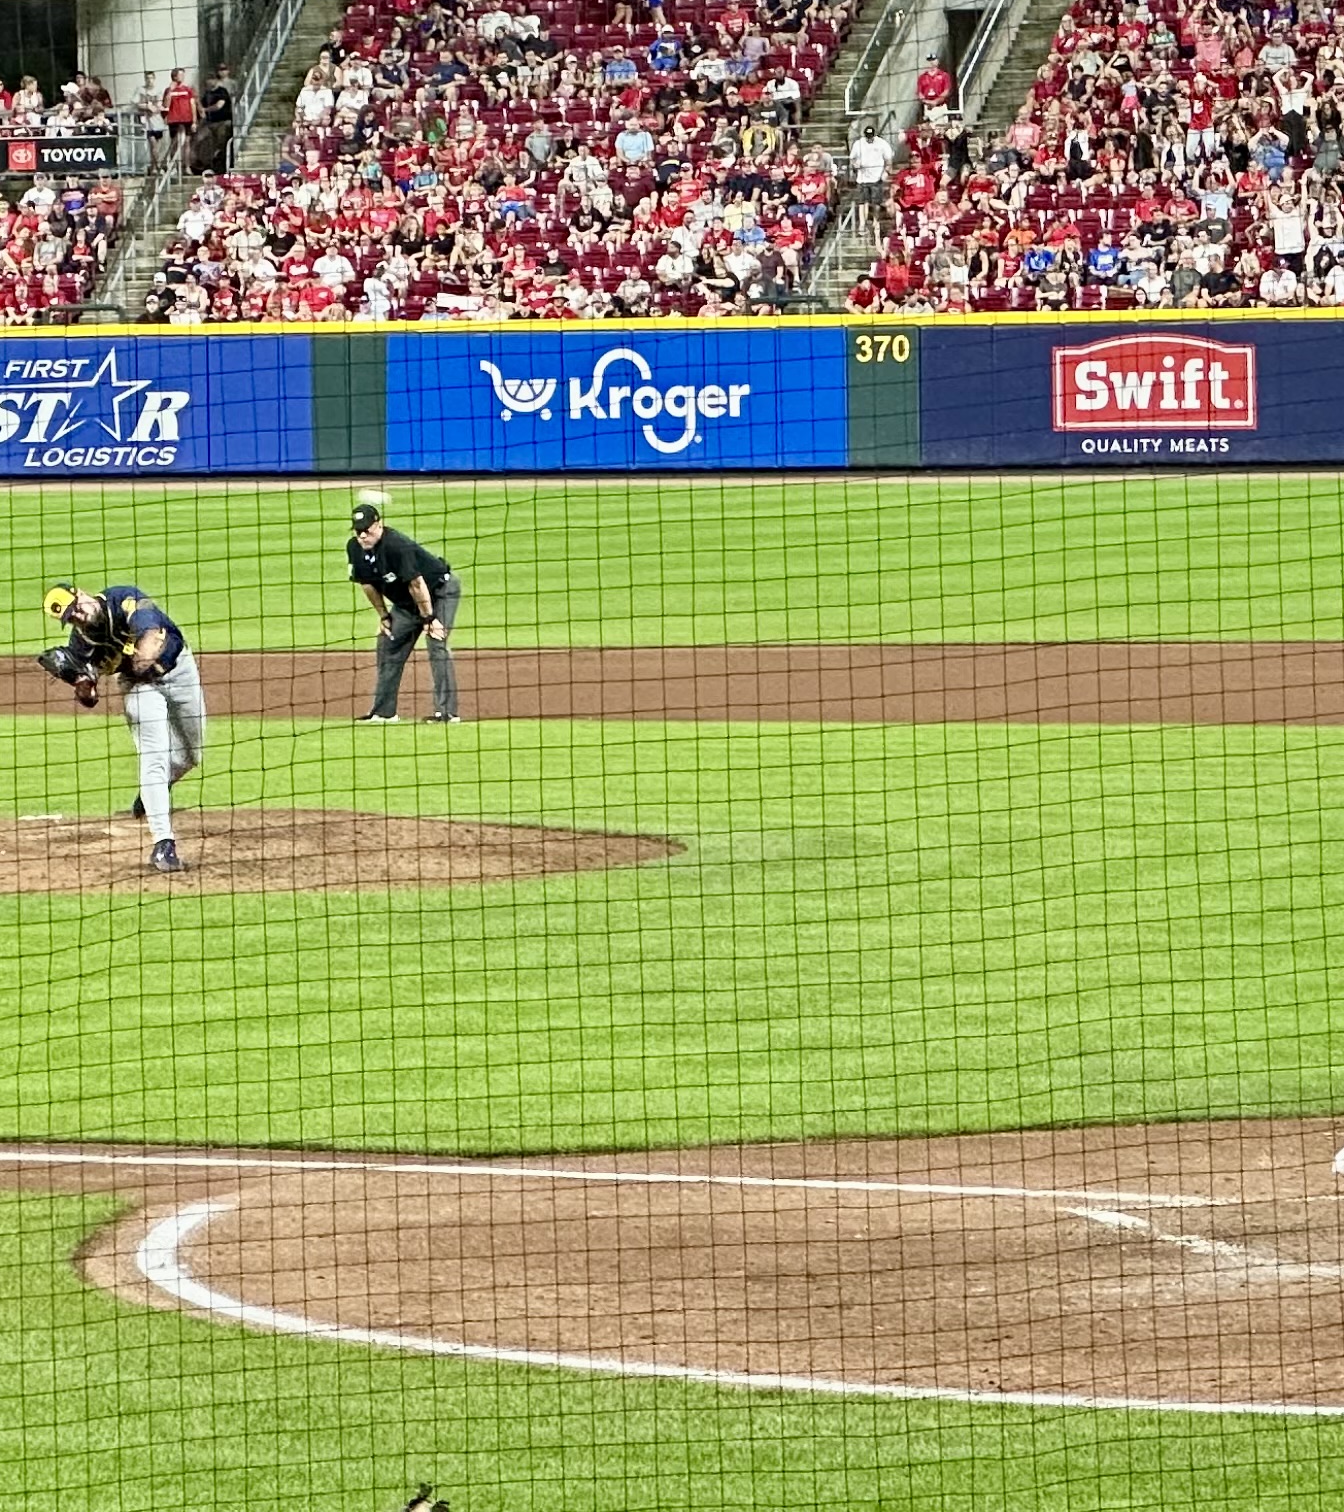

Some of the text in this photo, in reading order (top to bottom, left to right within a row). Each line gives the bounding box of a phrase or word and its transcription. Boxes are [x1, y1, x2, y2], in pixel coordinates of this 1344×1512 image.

[41, 147, 106, 163] TOYOTA
[855, 334, 911, 364] 370
[3, 359, 90, 379] FIRST
[1074, 355, 1231, 411] Swift
[570, 348, 750, 453] Kroger
[23, 445, 178, 468] LOGISTICS
[1081, 437, 1230, 454] QUALITY MEATS
